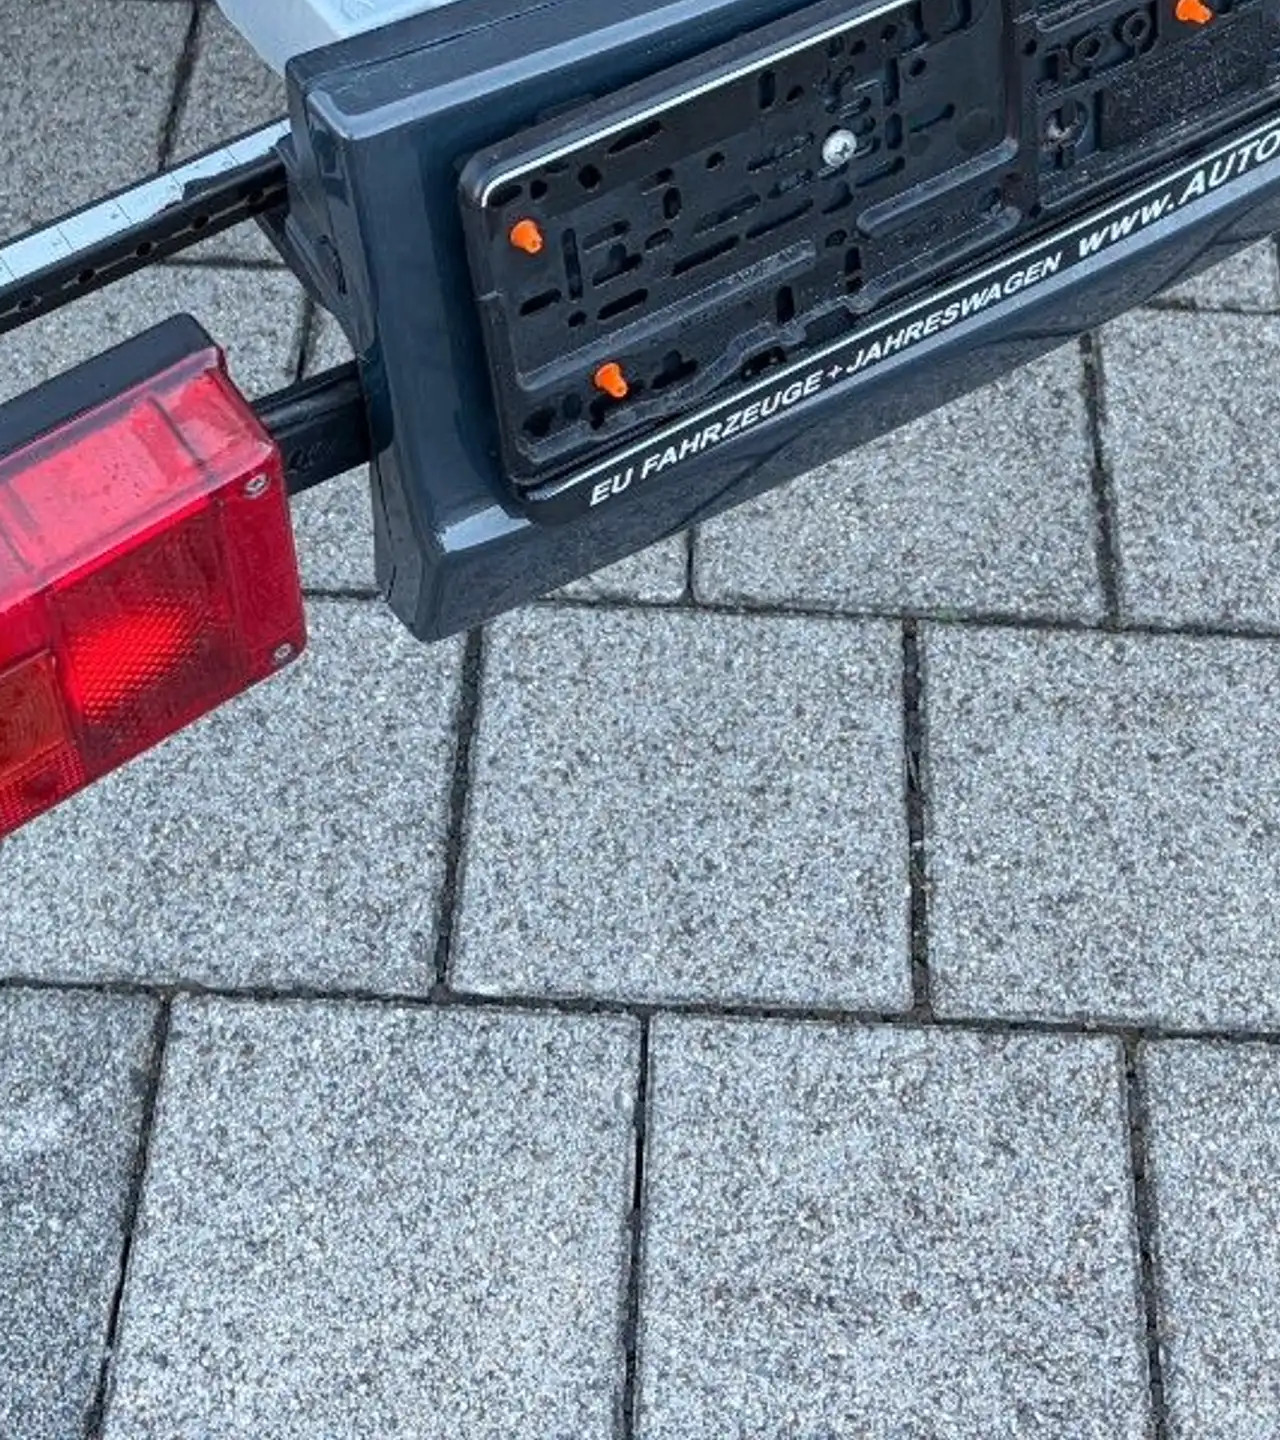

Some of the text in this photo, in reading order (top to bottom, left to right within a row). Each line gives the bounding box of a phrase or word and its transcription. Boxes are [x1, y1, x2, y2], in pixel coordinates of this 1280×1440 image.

[589, 468, 634, 507] EU
[640, 369, 824, 480] FAHRZEUGE
[846, 252, 1062, 373] JAHRESWAGEN
